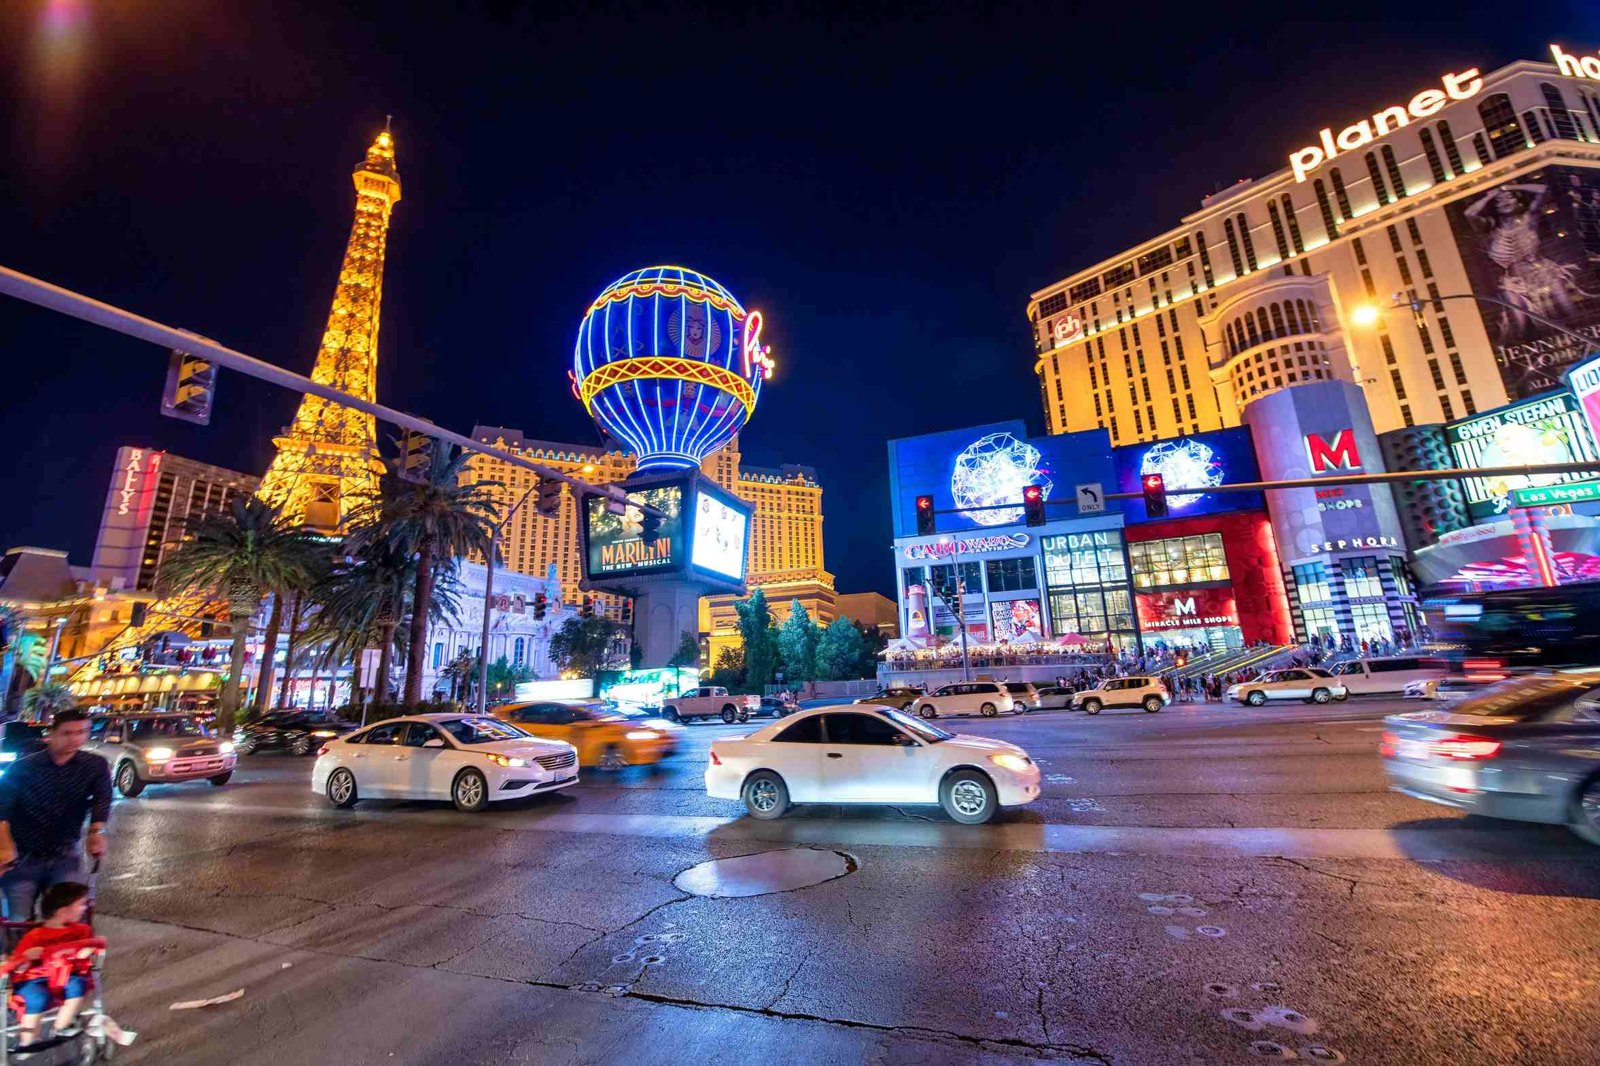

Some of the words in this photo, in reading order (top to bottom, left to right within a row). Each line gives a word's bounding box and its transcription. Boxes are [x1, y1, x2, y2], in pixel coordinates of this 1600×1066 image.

[1289, 67, 1484, 183] planet
[1550, 44, 1600, 80] ho
[1575, 366, 1600, 392] LIO
[1504, 398, 1567, 426] STEFANI
[1519, 492, 1547, 503] Las
[1549, 486, 1594, 501] Vegas
[1081, 503, 1101, 511] ONLY
[1317, 499, 1363, 511] SHOPS
[904, 539, 966, 560] CABO
[965, 535, 1014, 550] WABO
[1042, 531, 1108, 551] URBAN
[1311, 537, 1398, 553] SEPHORA
[601, 537, 671, 565] MARILYN!
[1045, 548, 1112, 567] OUTFIT
[638, 557, 671, 567] MUSICAL
[1174, 597, 1196, 615] M
[1145, 619, 1179, 628] MIRACLE
[1182, 617, 1201, 625] MILE
[1203, 615, 1233, 624] SHOPS
